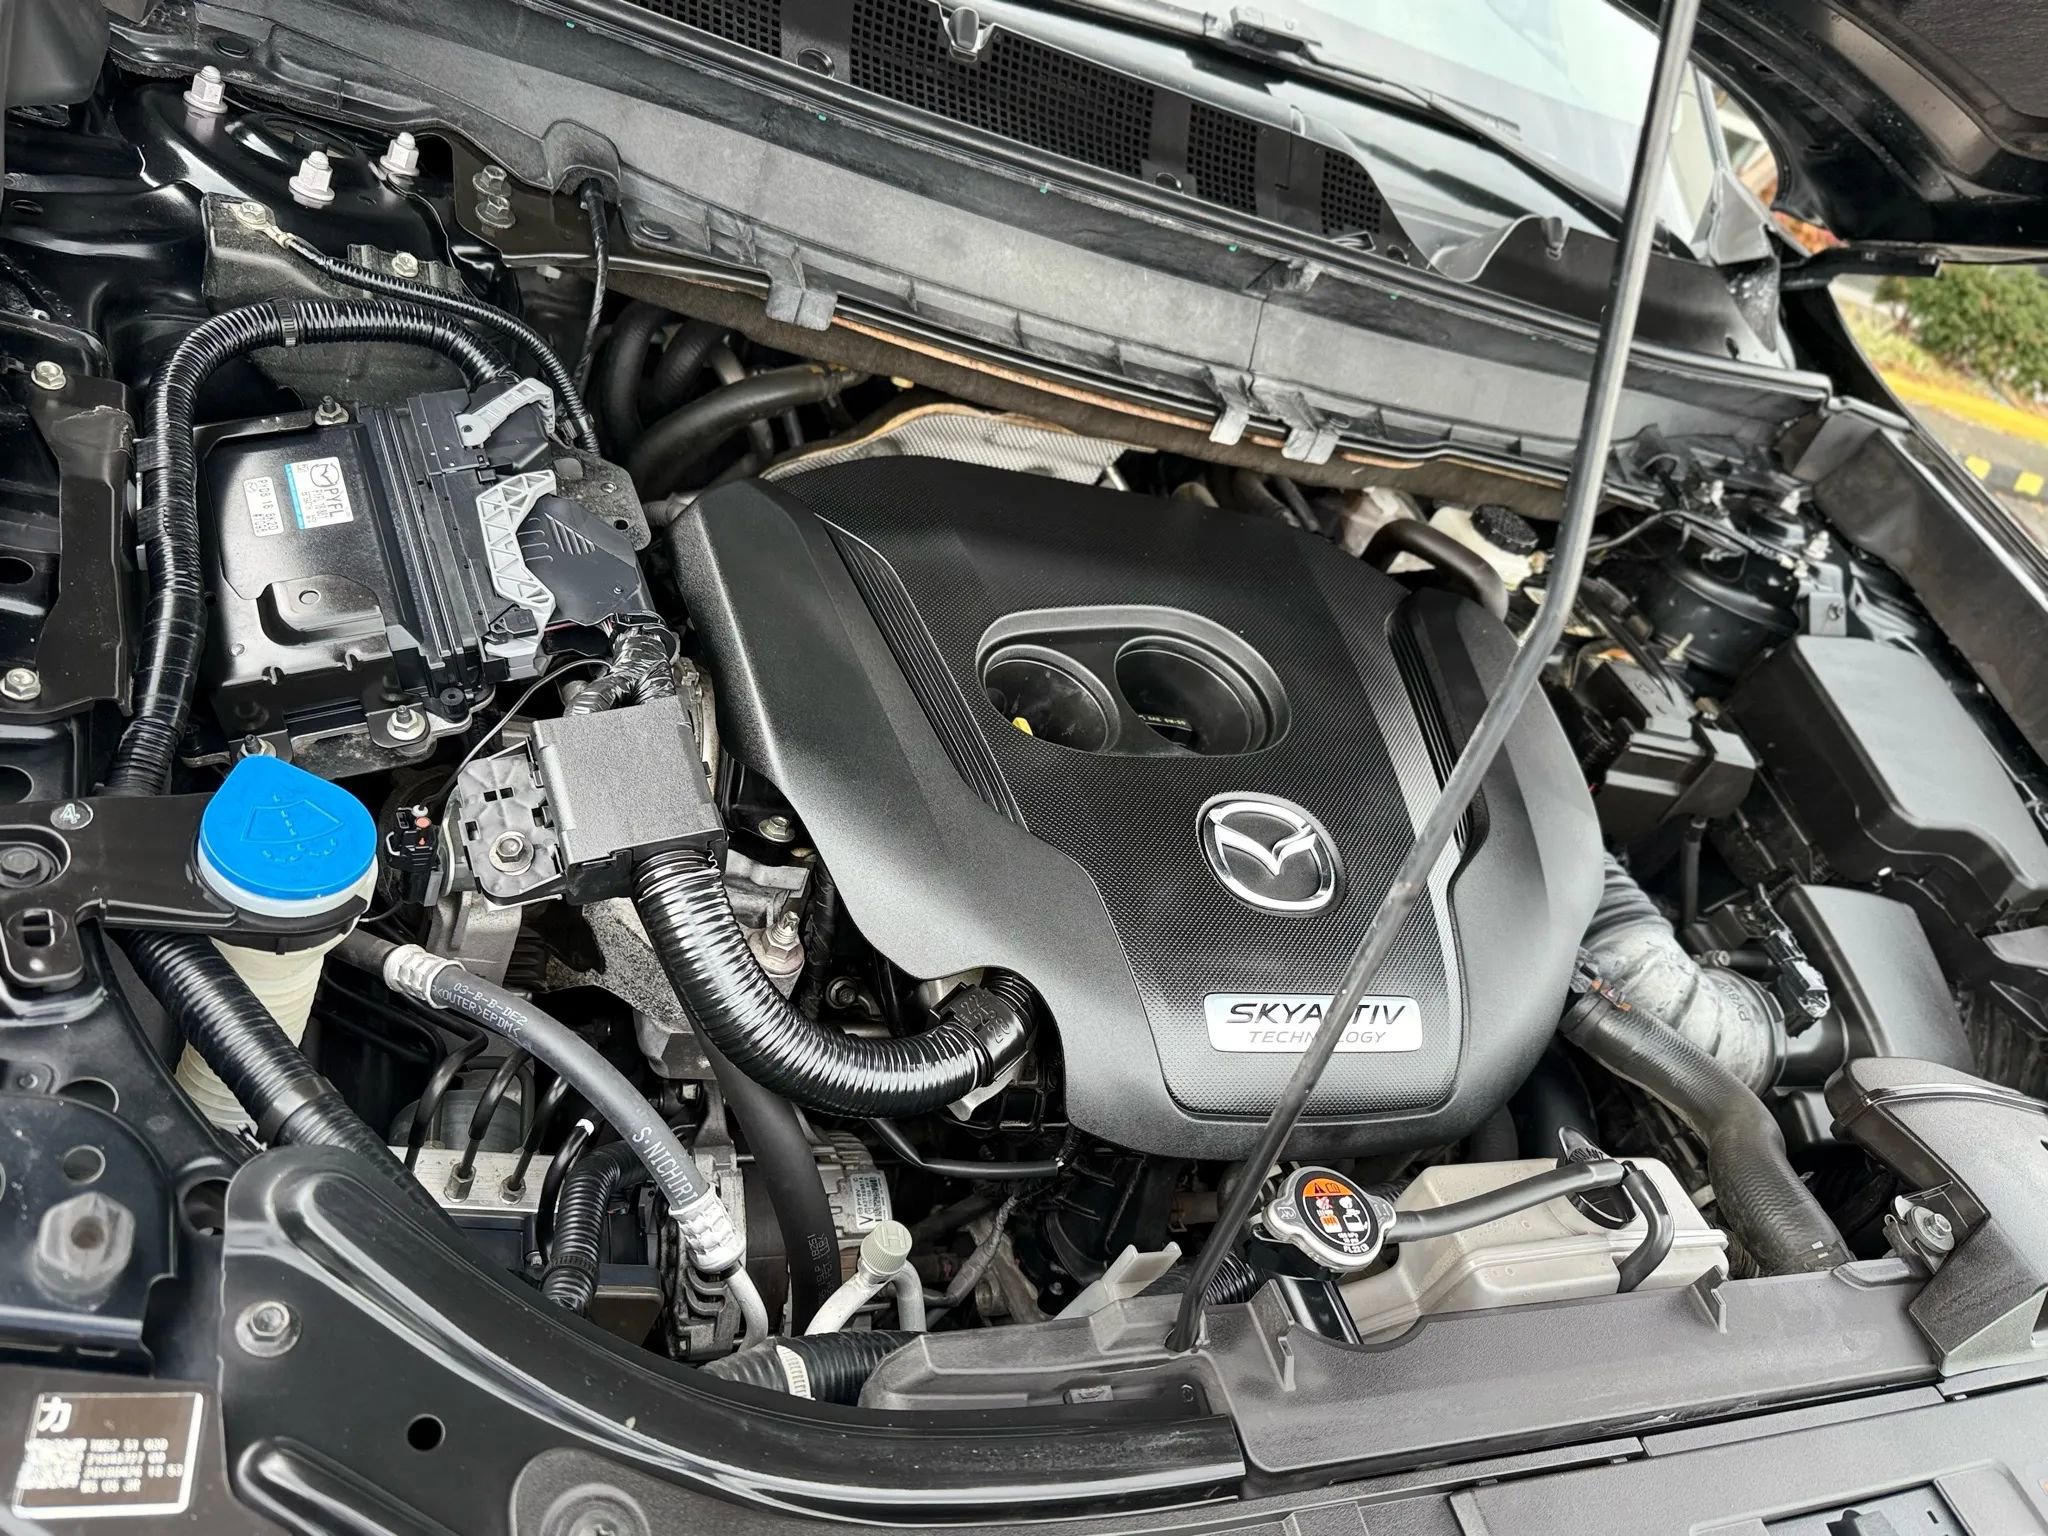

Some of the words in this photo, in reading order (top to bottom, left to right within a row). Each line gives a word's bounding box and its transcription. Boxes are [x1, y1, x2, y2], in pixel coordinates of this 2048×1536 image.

[324, 487, 344, 518] PYFL
[1226, 1002, 1406, 1025] SKYATIV
[1249, 1031, 1387, 1044] TECHNOGY
